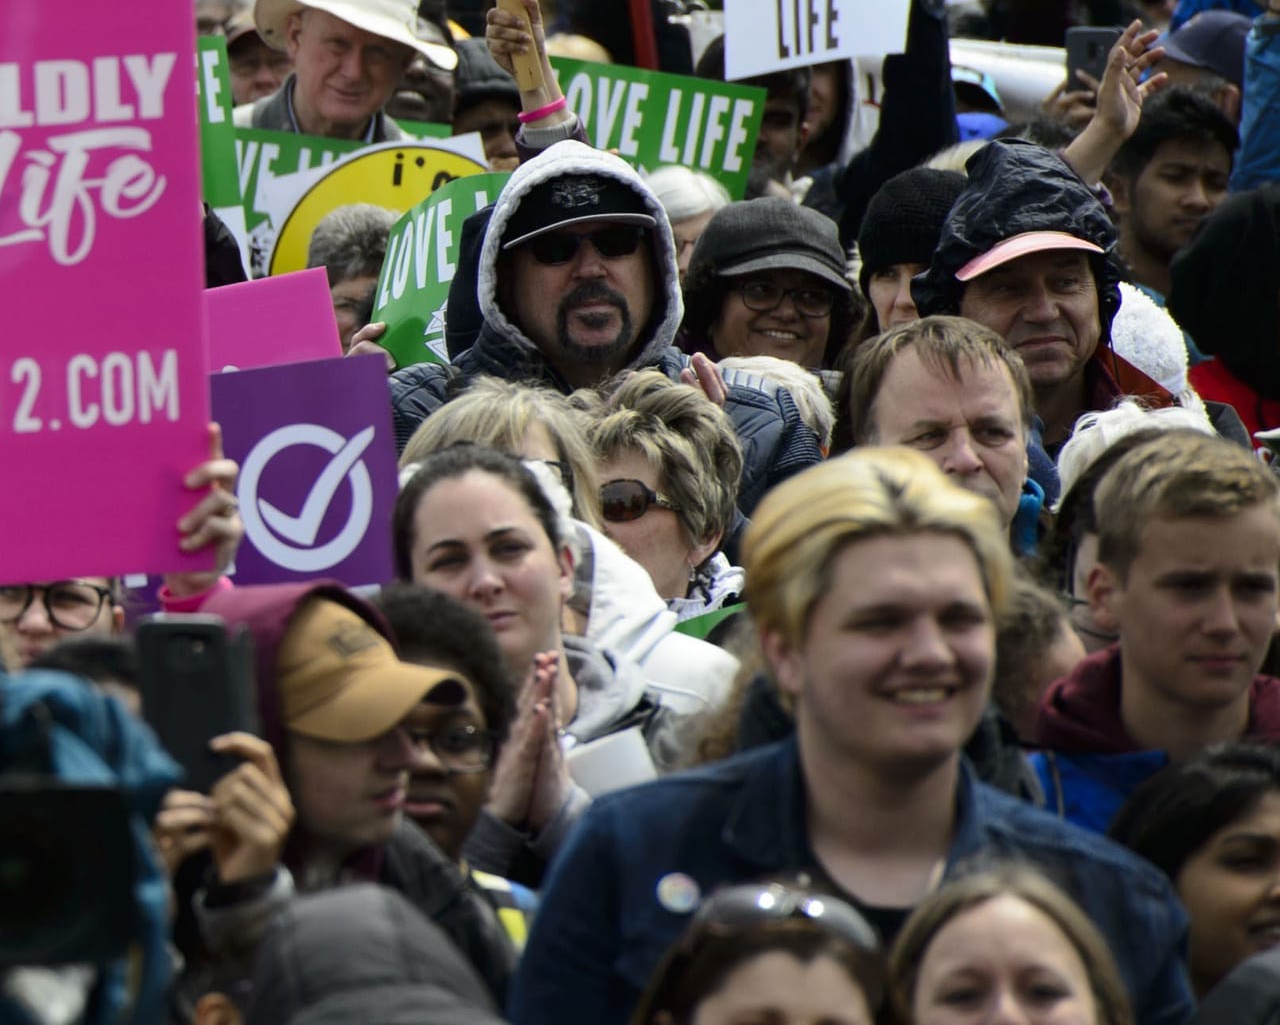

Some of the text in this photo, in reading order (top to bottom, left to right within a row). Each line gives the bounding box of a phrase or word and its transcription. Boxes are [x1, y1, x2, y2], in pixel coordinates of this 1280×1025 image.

[565, 77, 755, 173] OVE LIFE
[377, 196, 457, 312] LOVE
